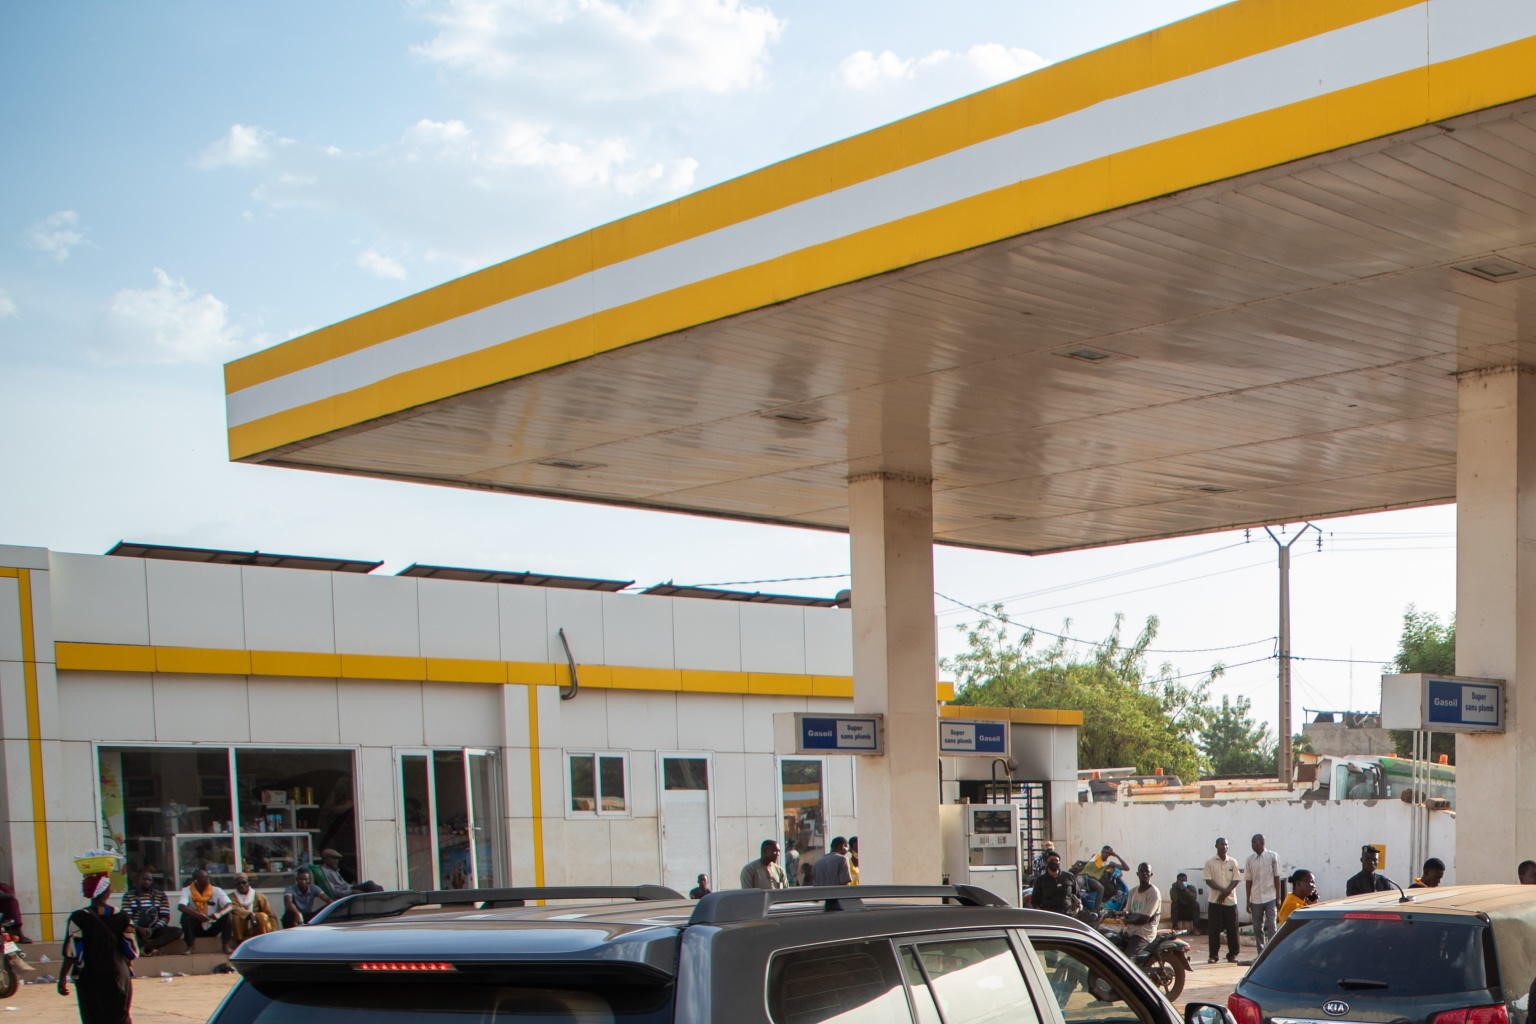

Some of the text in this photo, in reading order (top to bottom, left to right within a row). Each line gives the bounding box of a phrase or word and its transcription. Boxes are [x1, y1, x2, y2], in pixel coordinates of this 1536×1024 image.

[1471, 691, 1487, 702] Super
[1434, 697, 1458, 707] Gasoil
[1465, 704, 1478, 712] sans
[807, 729, 833, 737] Gasoil
[950, 729, 965, 737] Super
[979, 734, 1001, 742] Gasoil
[1327, 1003, 1345, 1012] KIA
